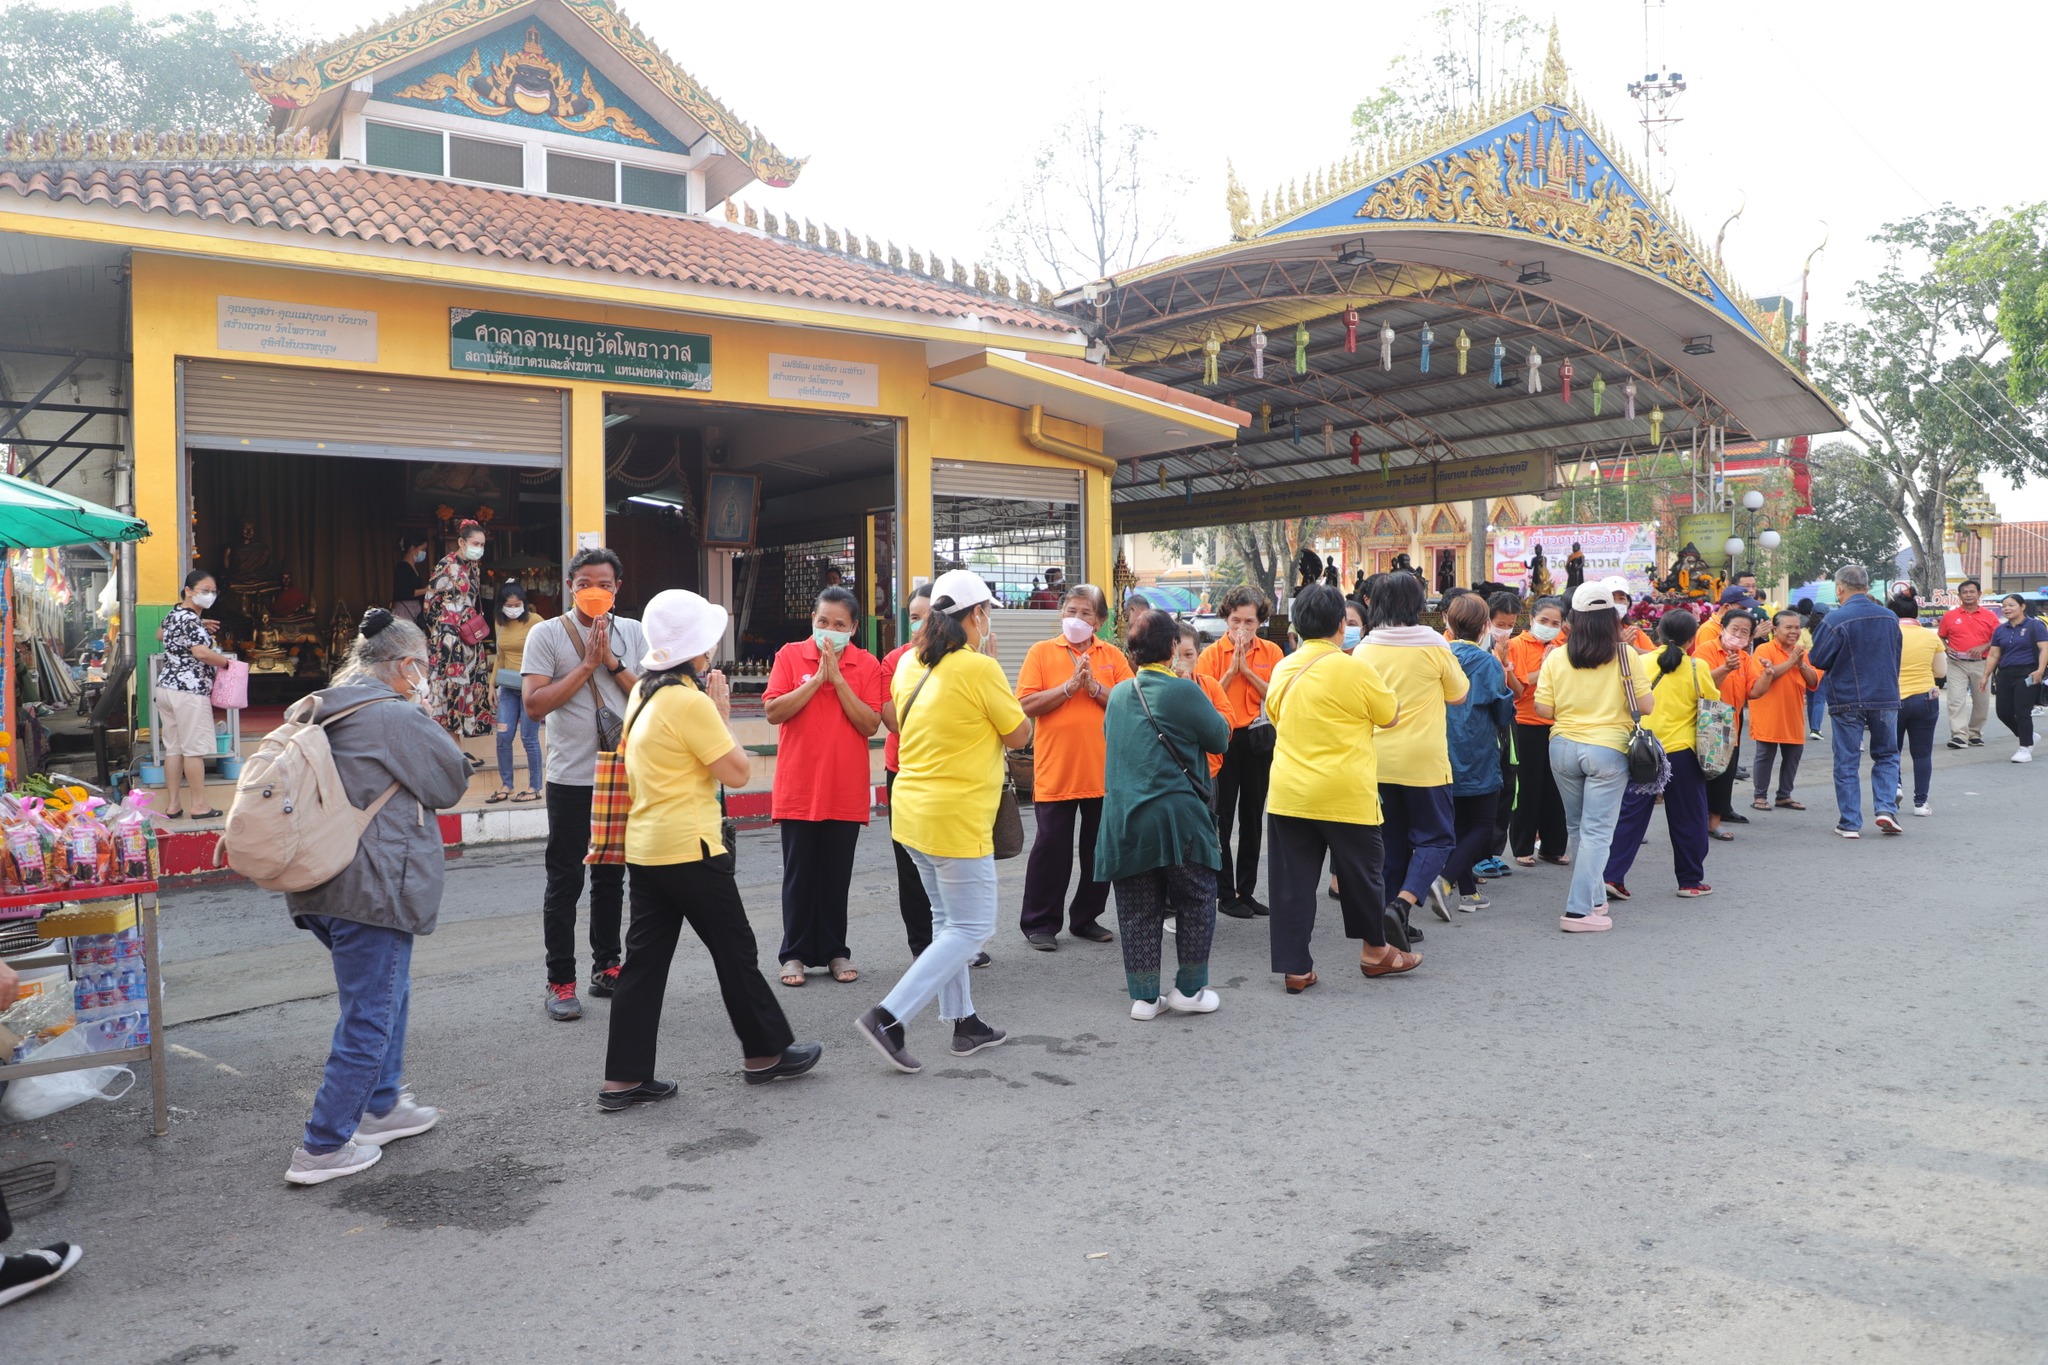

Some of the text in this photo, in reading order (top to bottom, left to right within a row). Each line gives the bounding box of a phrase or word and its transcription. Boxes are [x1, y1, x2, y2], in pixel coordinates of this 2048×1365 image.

[223, 318, 327, 337] สร้างถวาย วัดโพธาวาส
[260, 336, 337, 356] อุทิศให้บรรพบุรุษ
[474, 323, 692, 363] ศาลาลานบุญวัดโพธาวาส
[464, 349, 606, 374] สถานที่รับบาตรและสังฆทาน
[1471, 460, 1529, 478] เป็นประจำทุกปี
[1550, 556, 1621, 569] วัดธาวาส
